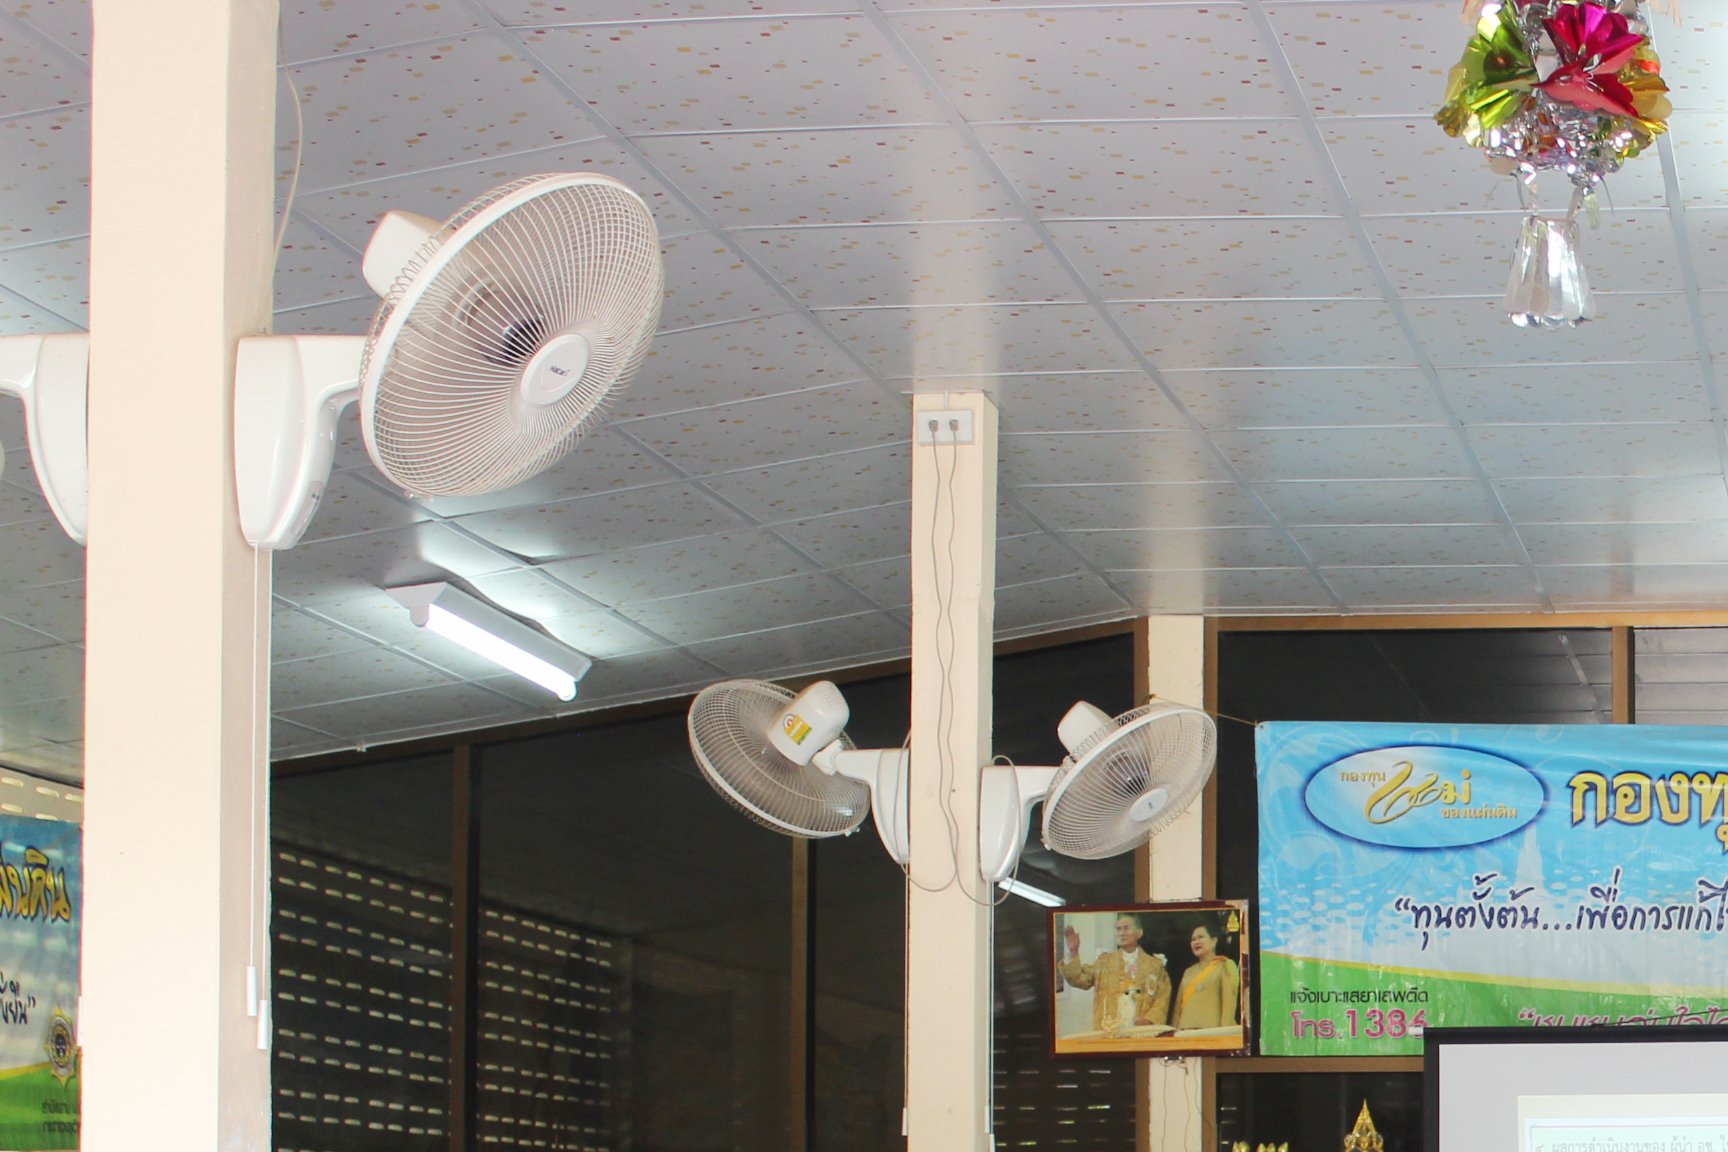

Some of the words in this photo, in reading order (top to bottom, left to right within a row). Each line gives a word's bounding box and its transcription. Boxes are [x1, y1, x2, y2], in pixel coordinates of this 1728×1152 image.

[1339, 769, 1387, 788] กองทุน
[1440, 802, 1518, 819] ของแผ่นดิน
[1289, 986, 1429, 1004] แจ้งเบาะแสยาเสพติด
